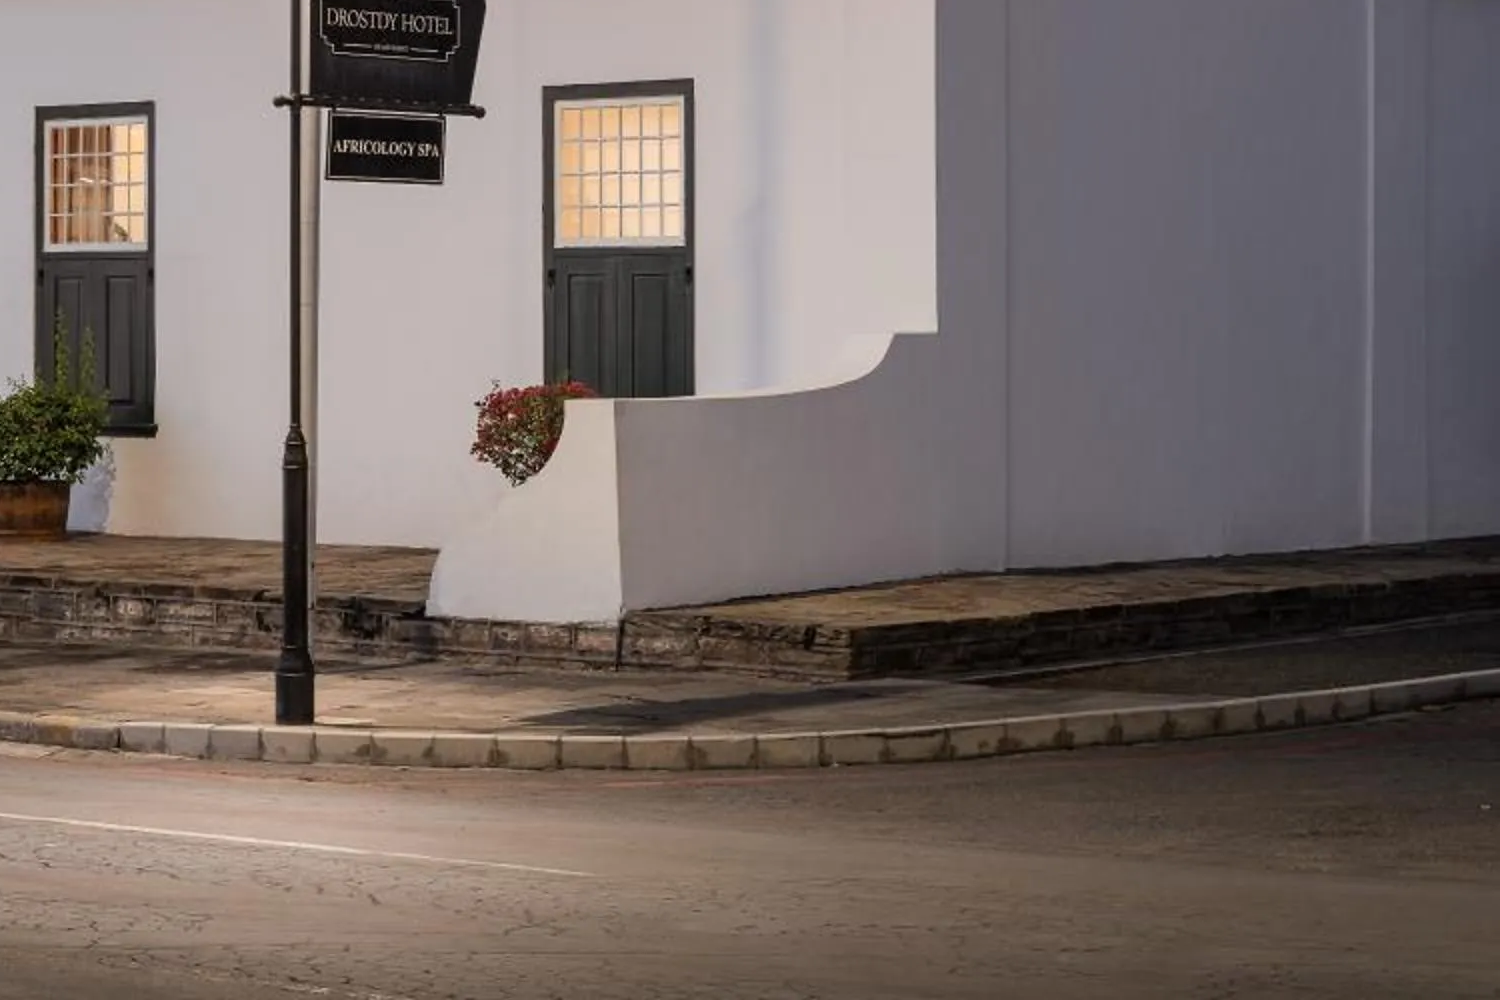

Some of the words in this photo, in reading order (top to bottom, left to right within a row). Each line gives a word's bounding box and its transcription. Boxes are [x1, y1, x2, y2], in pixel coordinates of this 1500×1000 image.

[327, 7, 398, 31] DROSTDY
[401, 12, 453, 35] HOTEL
[333, 139, 415, 157] AFRICOLOGY
[418, 143, 439, 158] SPA
